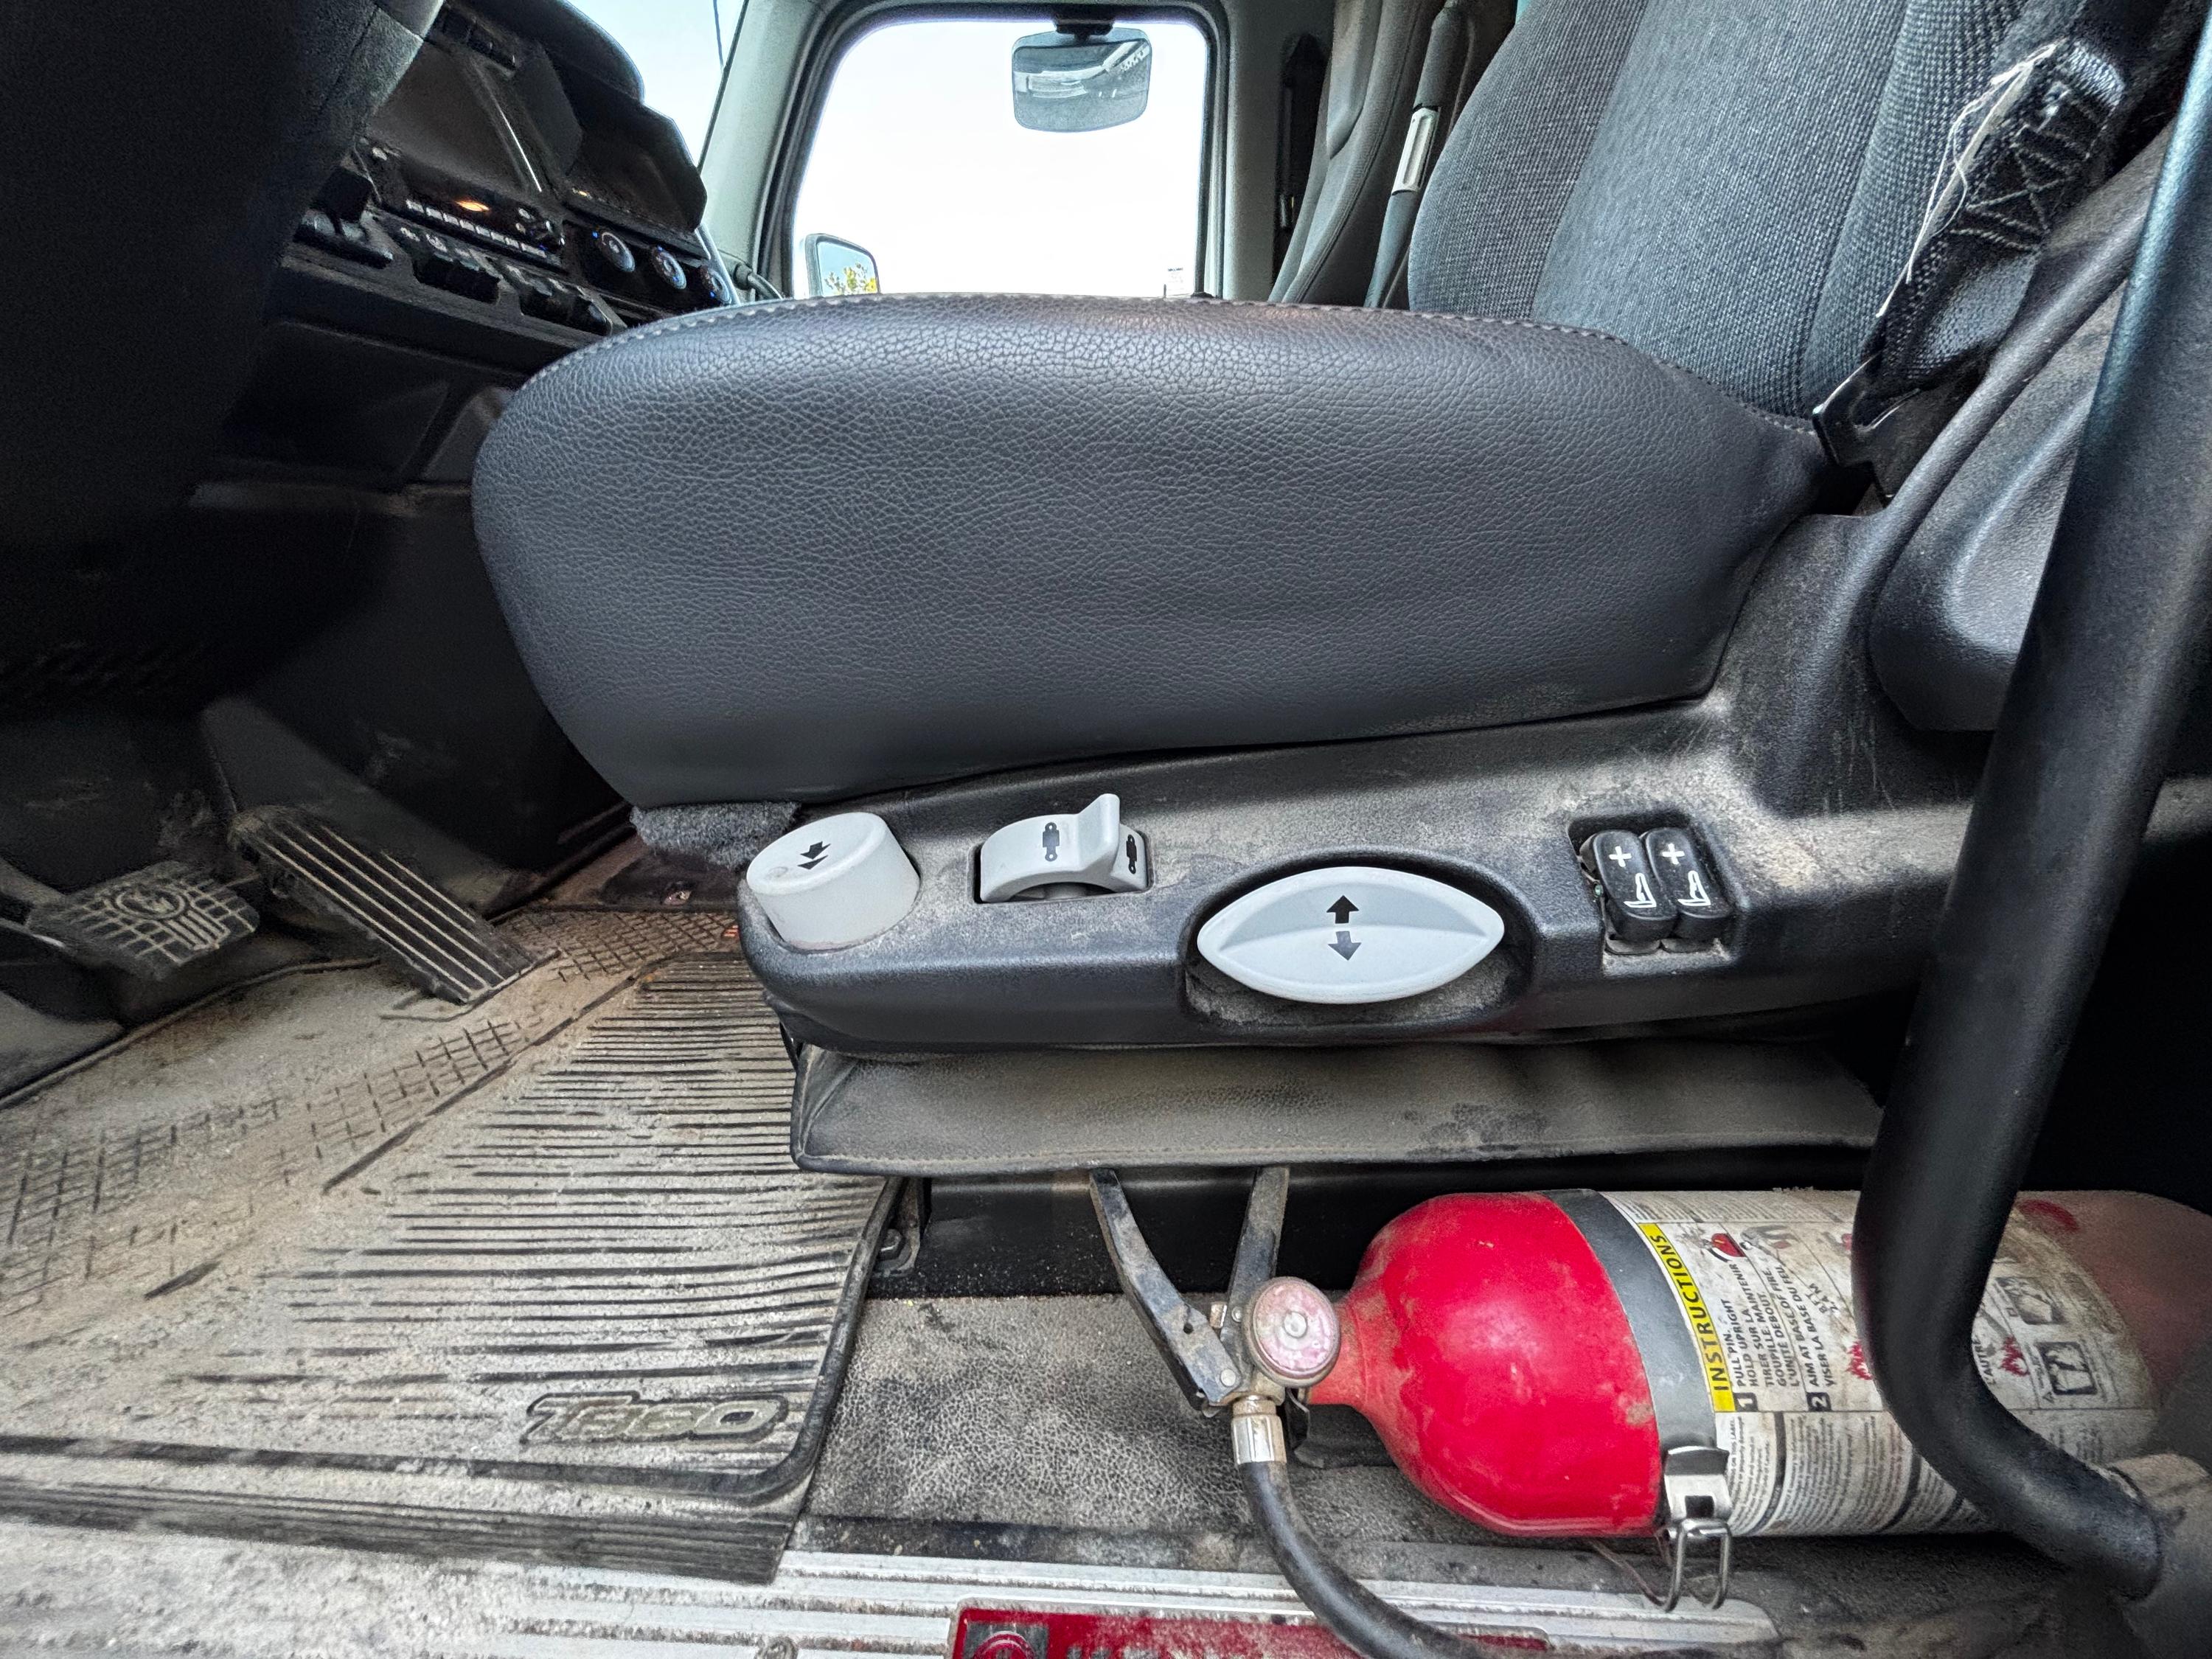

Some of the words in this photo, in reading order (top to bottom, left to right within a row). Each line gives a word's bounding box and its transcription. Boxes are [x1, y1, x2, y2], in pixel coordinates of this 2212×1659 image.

[1762, 1268, 1781, 1292] FIRE.
[1775, 1265, 1792, 1284] FEU.
[1729, 1264, 1766, 1322] MAINTENIR
[1775, 1294, 1790, 1309] OF
[1787, 1287, 1803, 1301] DU
[1651, 1235, 1729, 1391] INSTRUCTIONS
[1721, 1298, 1747, 1349] UPRIGHT
[1742, 1309, 1754, 1323] LA
[1797, 1304, 1817, 1332] BASE
[1749, 1327, 1764, 1350] SUR
[1784, 1312, 1805, 1341] BASE
[1723, 1330, 1738, 1353] PIN.
[1799, 1345, 1812, 1360] AT
[1811, 1335, 1823, 1350] LA
[1761, 1326, 1787, 1386] GOUPILLE.
[1731, 1357, 1746, 1387] PULL
[1742, 1354, 1759, 1387] HOLD
[1758, 1354, 1775, 1387] TIRER
[1805, 1363, 1819, 1386] AIM
[1817, 1354, 1837, 1386] VISER
